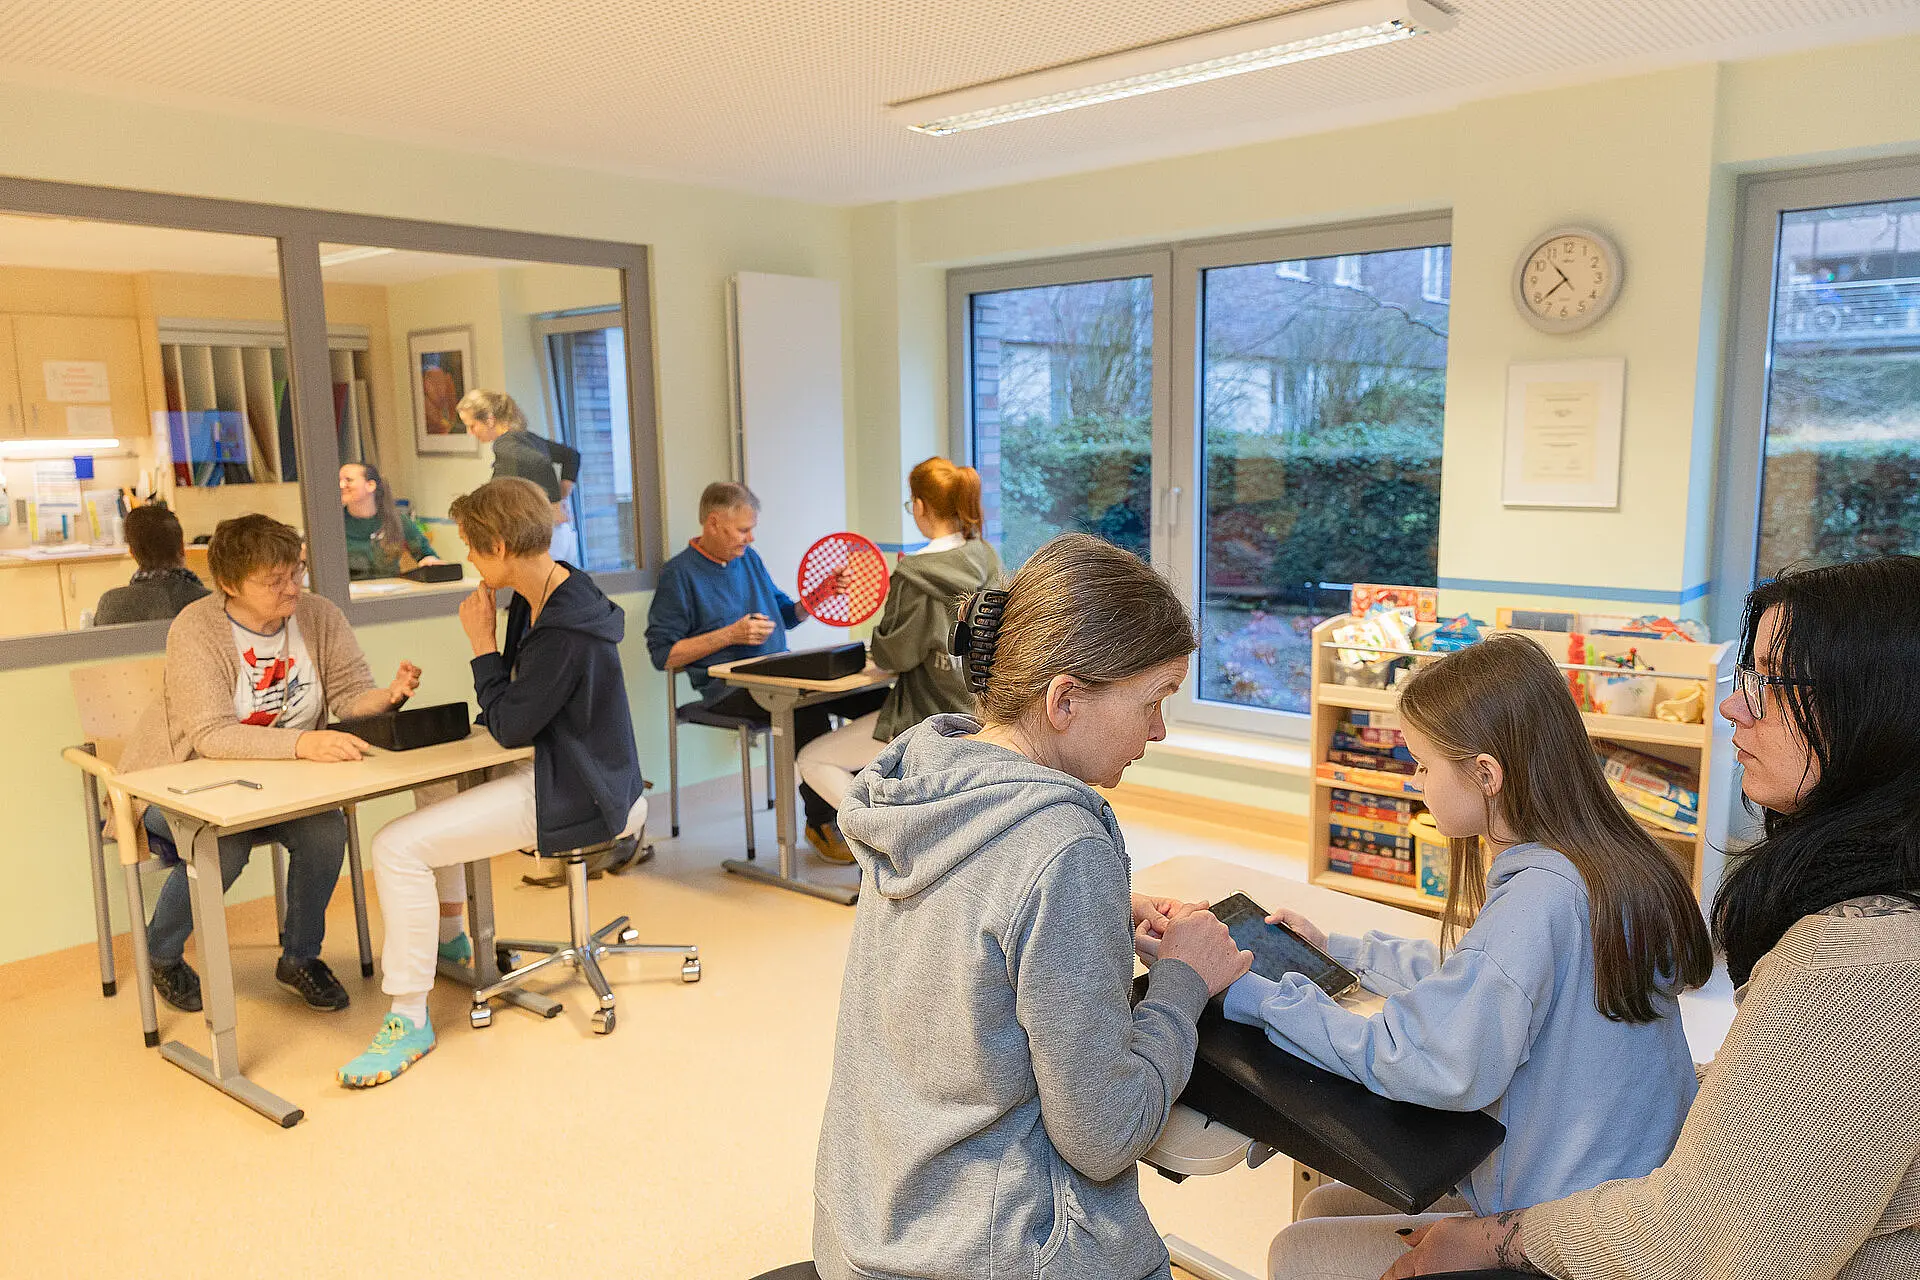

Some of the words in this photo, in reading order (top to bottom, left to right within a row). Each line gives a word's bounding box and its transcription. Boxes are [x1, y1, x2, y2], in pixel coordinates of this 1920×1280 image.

[1563, 241, 1575, 254] 12
[1582, 245, 1588, 256] 1
[1590, 256, 1600, 269] 2
[1593, 271, 1603, 284] 3
[1588, 290, 1597, 299] 4
[1559, 305, 1568, 318] 6
[1577, 300, 1585, 313] 5
